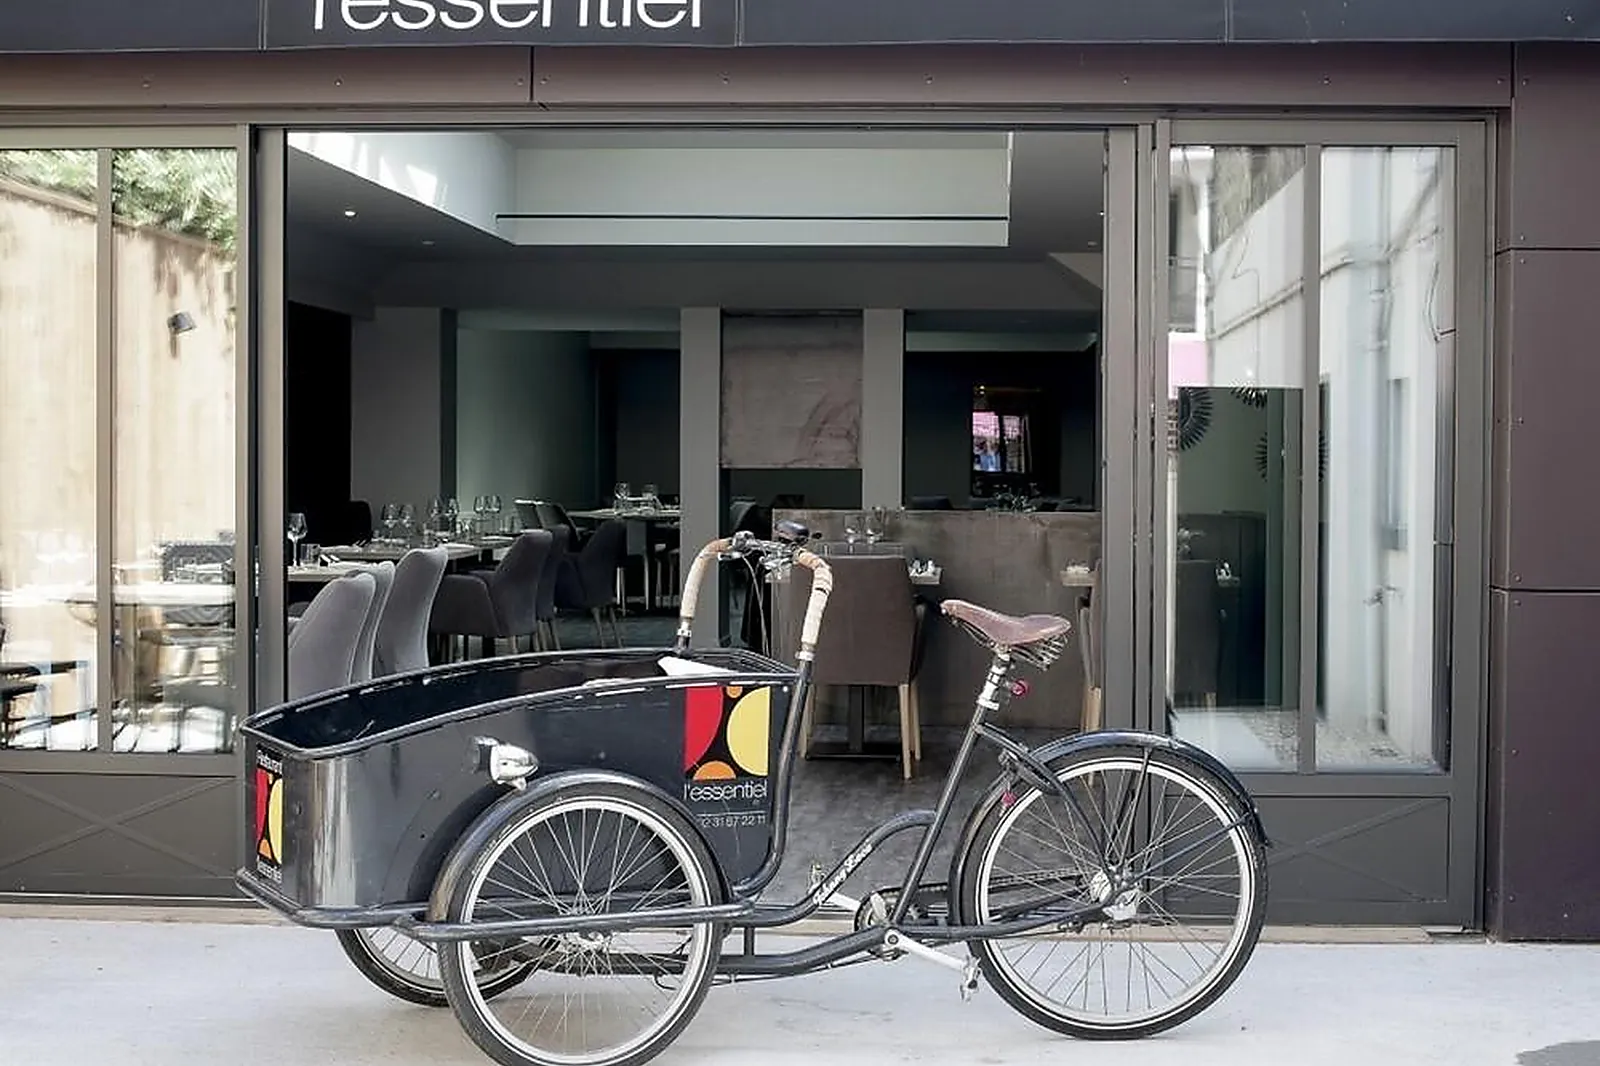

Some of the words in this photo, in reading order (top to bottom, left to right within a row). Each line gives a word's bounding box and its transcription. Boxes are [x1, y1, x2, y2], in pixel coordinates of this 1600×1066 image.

[313, 0, 701, 30] essente
[683, 780, 768, 801] l'essentiel
[741, 815, 755, 827] 22
